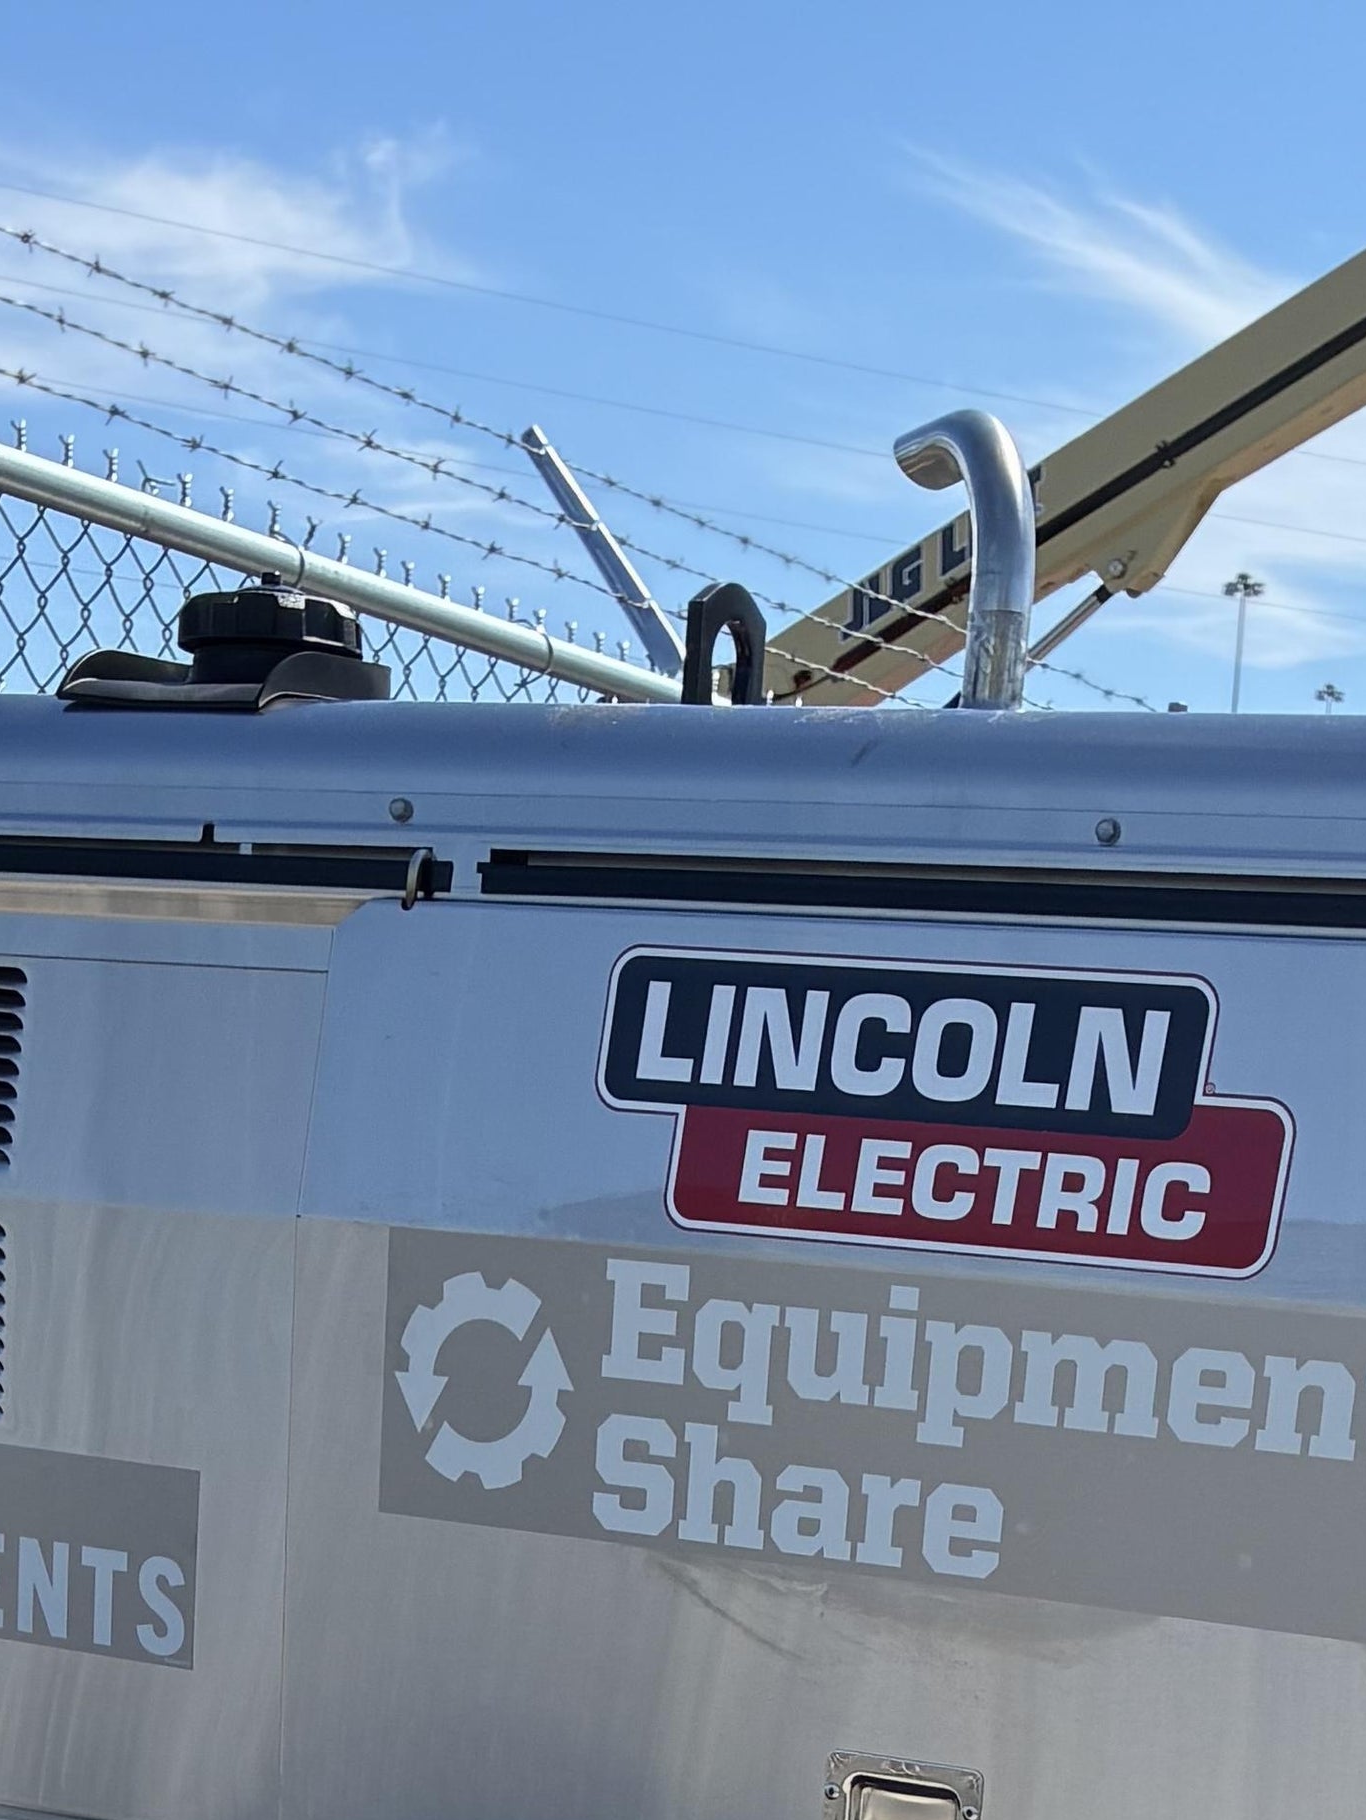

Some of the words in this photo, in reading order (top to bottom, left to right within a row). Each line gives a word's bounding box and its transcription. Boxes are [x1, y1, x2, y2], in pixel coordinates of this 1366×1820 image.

[636, 979, 1172, 1117] LINCOLN
[738, 1129, 1212, 1241] ELECTRIC
[591, 1412, 1006, 1580] Share
